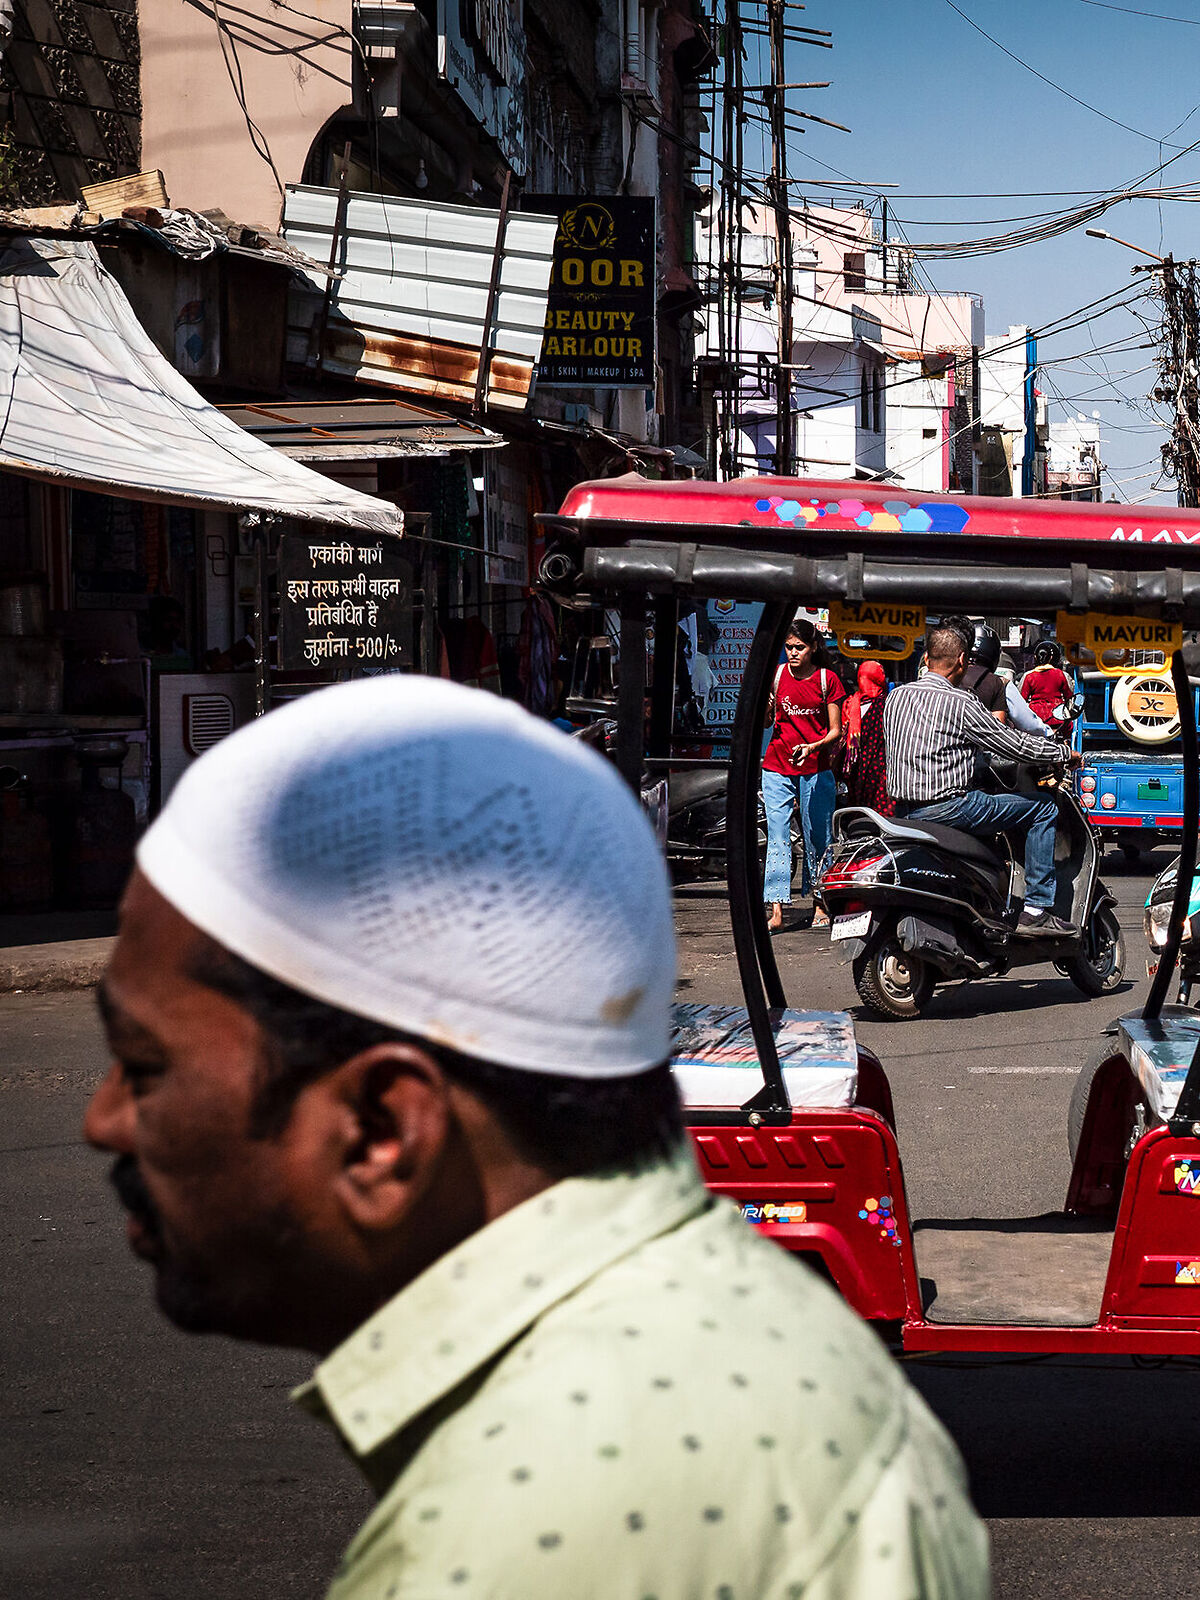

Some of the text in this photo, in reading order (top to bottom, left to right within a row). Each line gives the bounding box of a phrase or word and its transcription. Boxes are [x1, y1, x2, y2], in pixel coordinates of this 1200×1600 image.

[552, 257, 645, 288] OOR
[543, 336, 643, 358] ARLOUR
[558, 366, 577, 377] SKIN
[586, 367, 620, 377] MAKEUP
[629, 367, 645, 378] SPA
[308, 541, 383, 568] एकांकी मार्ग
[287, 573, 401, 603] इस तरफ सभी वाहन
[305, 599, 379, 627] प्रतिबंधित है
[1094, 624, 1174, 643] MAYURI
